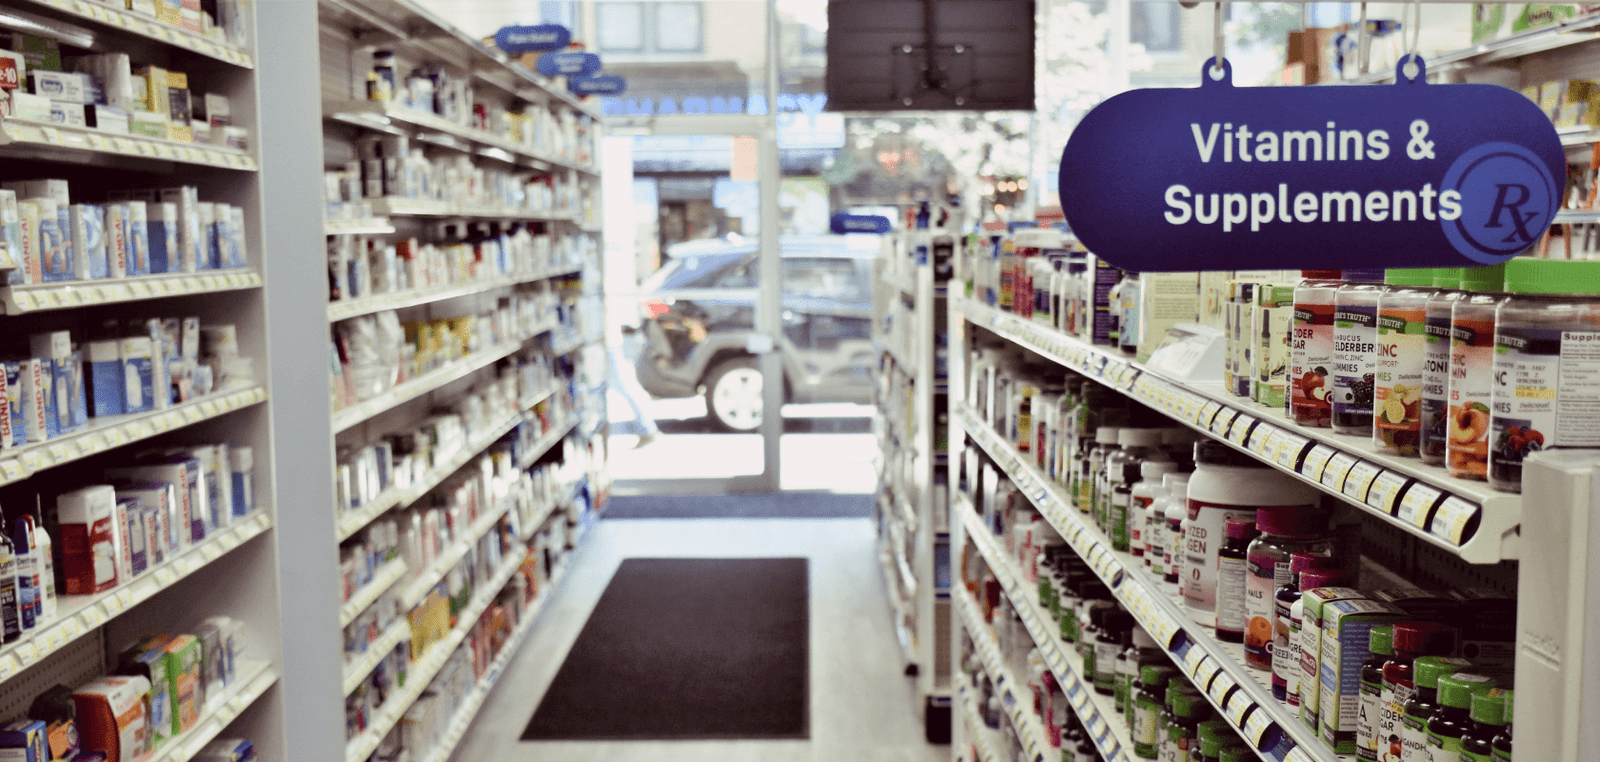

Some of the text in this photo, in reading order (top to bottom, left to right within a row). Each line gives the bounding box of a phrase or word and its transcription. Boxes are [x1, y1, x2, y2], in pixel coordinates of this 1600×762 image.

[1190, 119, 1436, 163] Vitamins &
[1164, 183, 1463, 232] Supplements
[1335, 342, 1377, 353] ELDERBER
[1359, 703, 1368, 722] A
